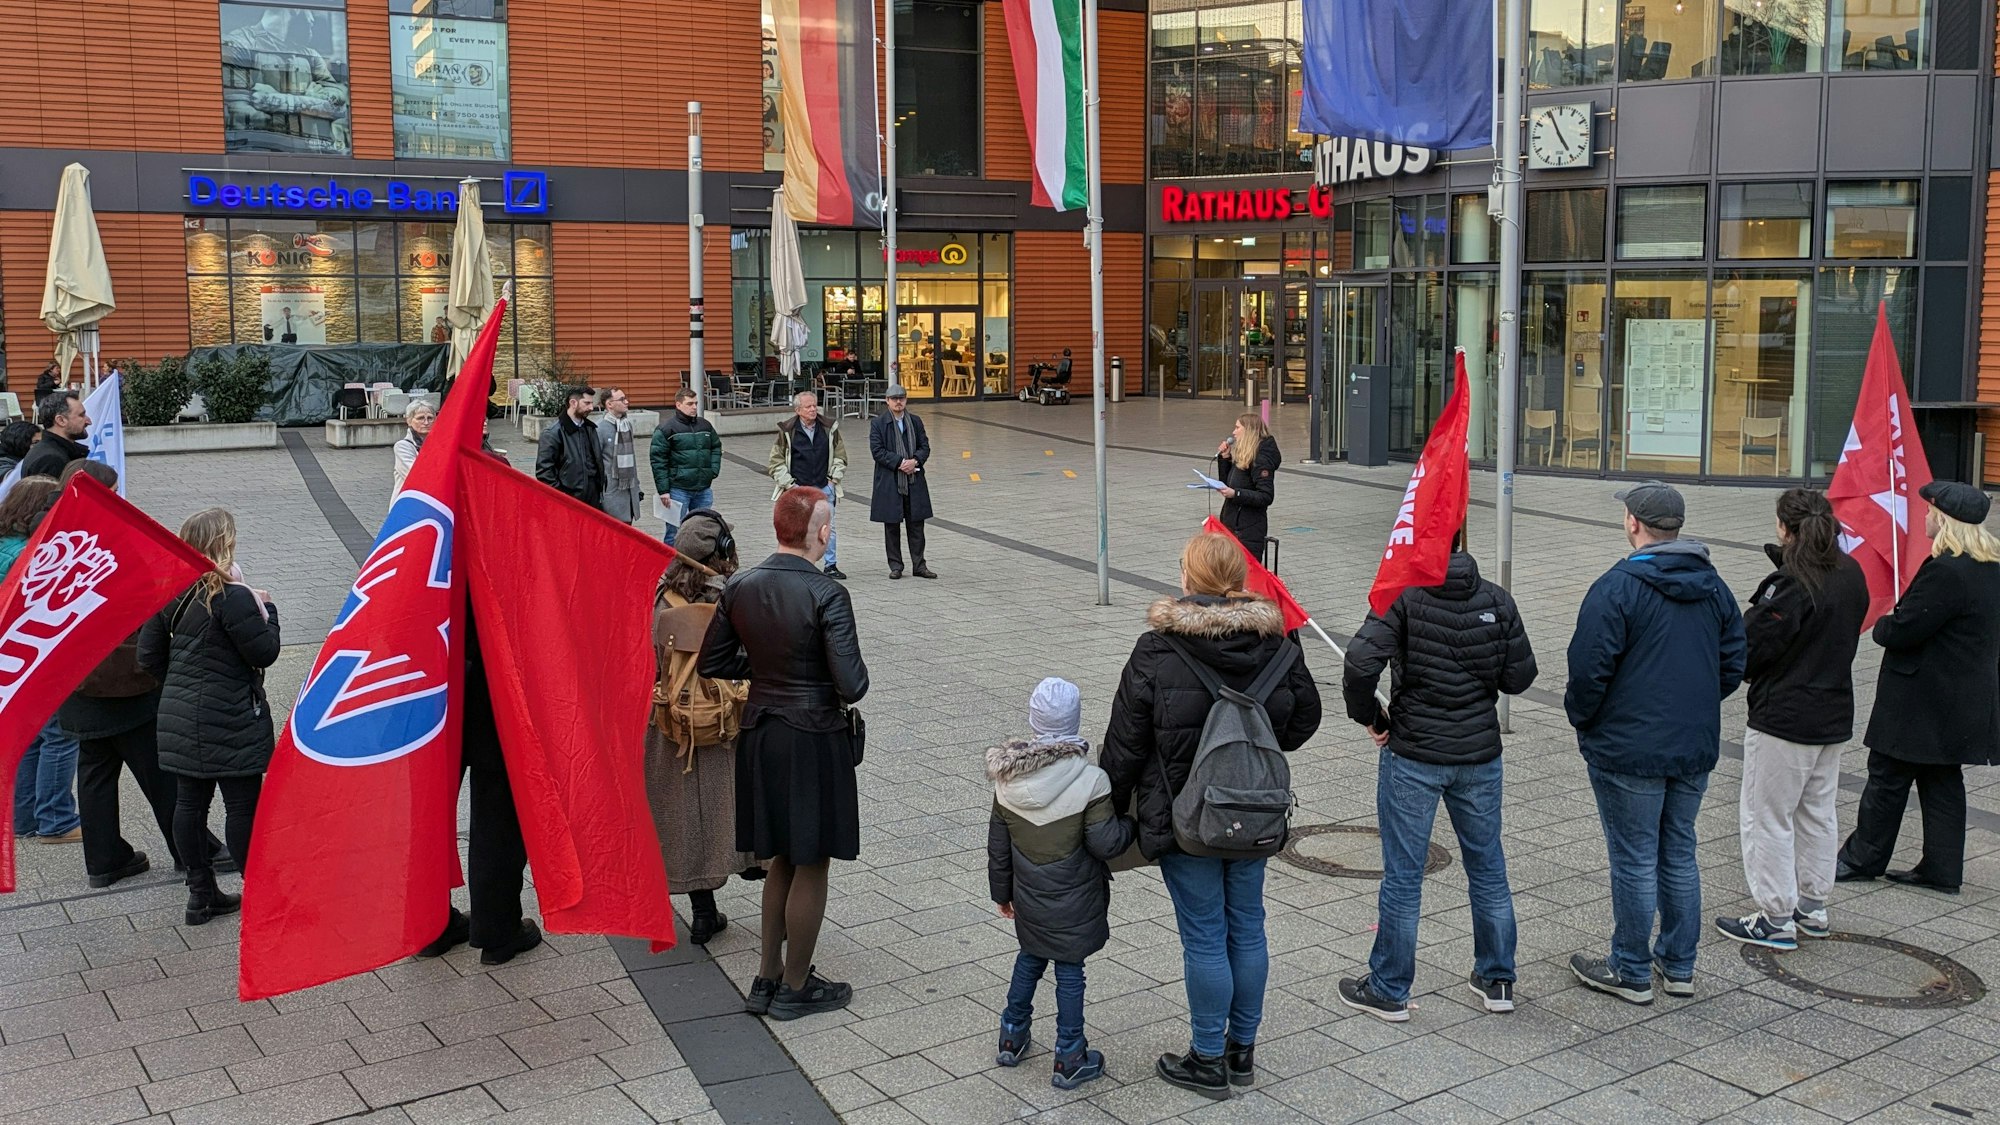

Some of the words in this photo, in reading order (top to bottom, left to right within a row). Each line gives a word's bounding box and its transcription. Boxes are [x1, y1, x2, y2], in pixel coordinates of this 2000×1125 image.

[1315, 126, 1430, 187] ATHAUS
[189, 175, 373, 210] Deutsche
[388, 181, 462, 211] Ban
